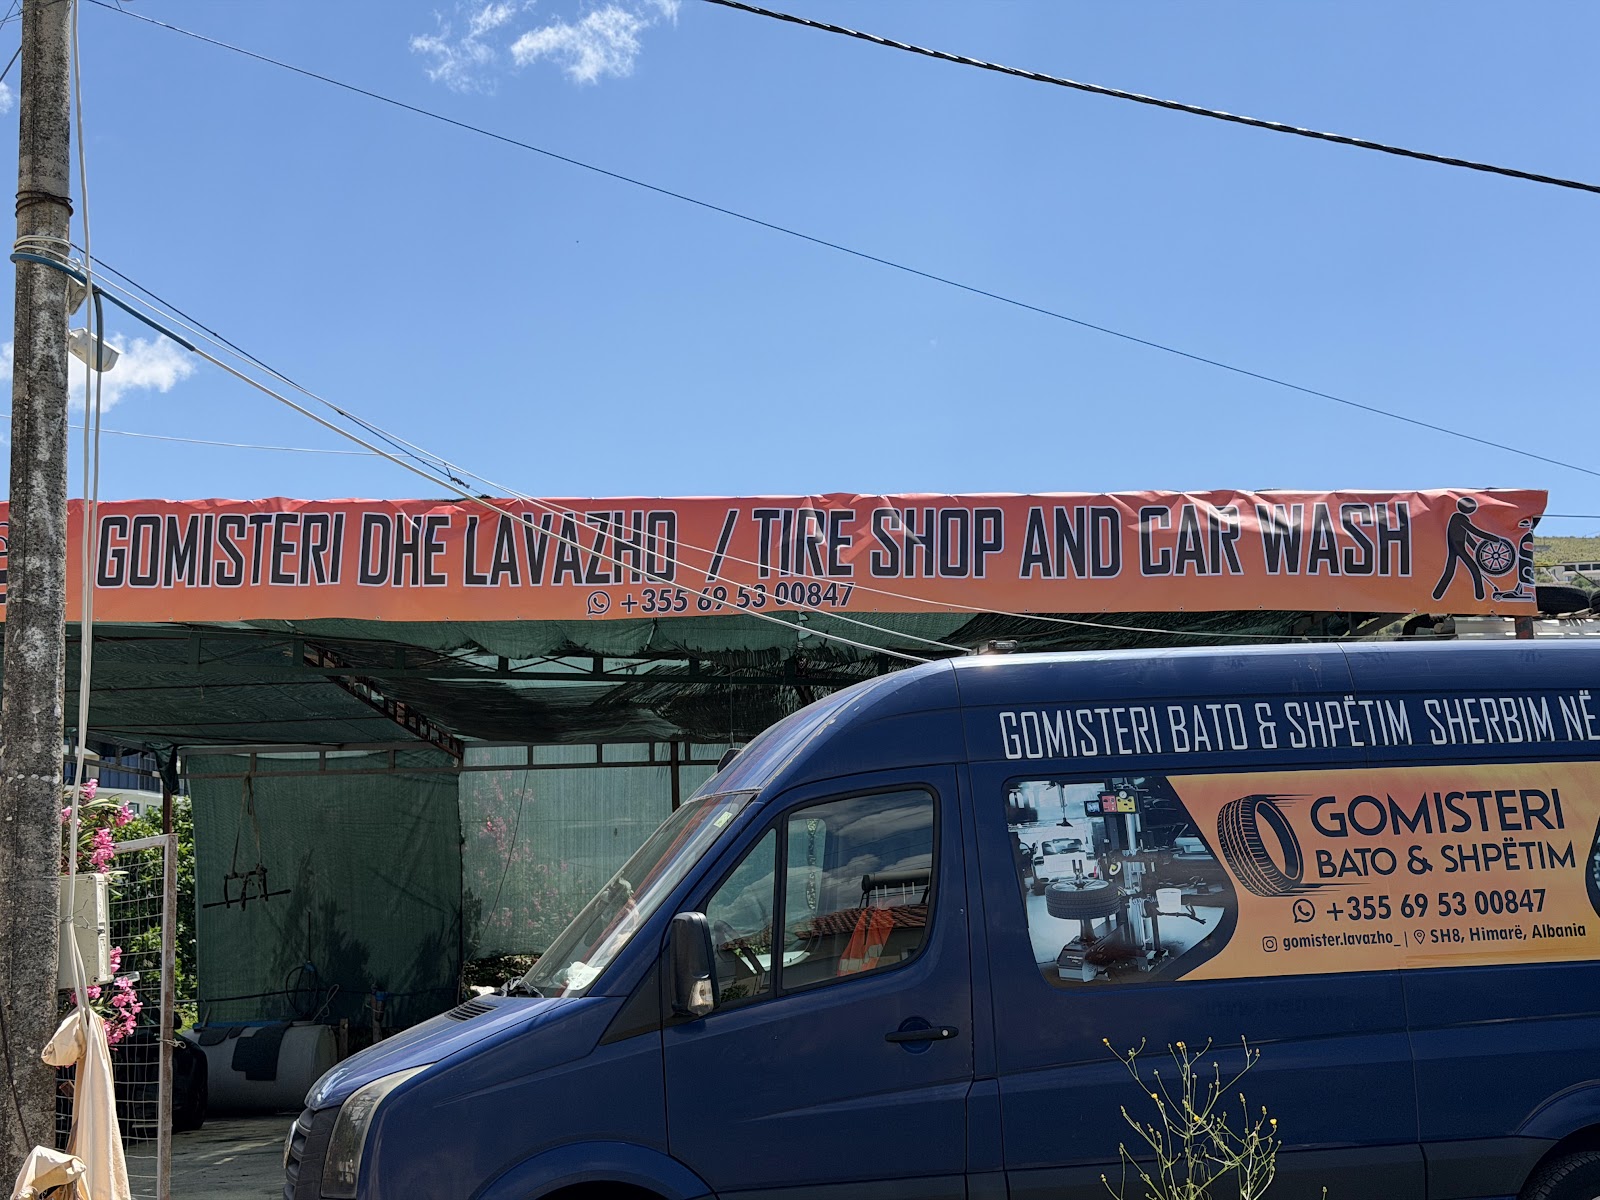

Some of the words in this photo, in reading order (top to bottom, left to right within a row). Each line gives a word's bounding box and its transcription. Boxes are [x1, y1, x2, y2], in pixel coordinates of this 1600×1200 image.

[97, 511, 346, 588] GOMISTERI
[357, 511, 451, 587] DHE
[463, 509, 677, 587] LAVAZHO
[707, 508, 740, 582] /
[753, 506, 854, 579] TIRE
[870, 507, 1004, 579] SHOP
[1019, 505, 1122, 579] AND
[1139, 504, 1245, 577] CAR
[1256, 501, 1413, 577] WASH
[620, 588, 689, 614] +355
[697, 586, 728, 612] 69
[735, 584, 767, 609] 53
[774, 581, 855, 608] 00847
[999, 706, 1162, 760] GOMISTERI
[1167, 703, 1248, 753] BATO
[1254, 702, 1278, 749] &
[1284, 695, 1413, 748] SHPËTIM
[1424, 696, 1556, 745] SHERBIM
[1558, 690, 1600, 742] NË
[1310, 788, 1565, 838] GOMISTERI
[1315, 847, 1397, 878] BATO
[1407, 845, 1433, 875] &
[1440, 837, 1576, 873] SHPËTIM
[1326, 895, 1392, 921] +355
[1400, 892, 1428, 918] 69
[1438, 891, 1467, 917] 53
[1475, 888, 1546, 915] 00847
[1282, 931, 1401, 951] gomister.lavazho_
[1430, 928, 1465, 944] SH8,
[1469, 924, 1528, 942] Himarë,
[1531, 922, 1587, 940] Albania
